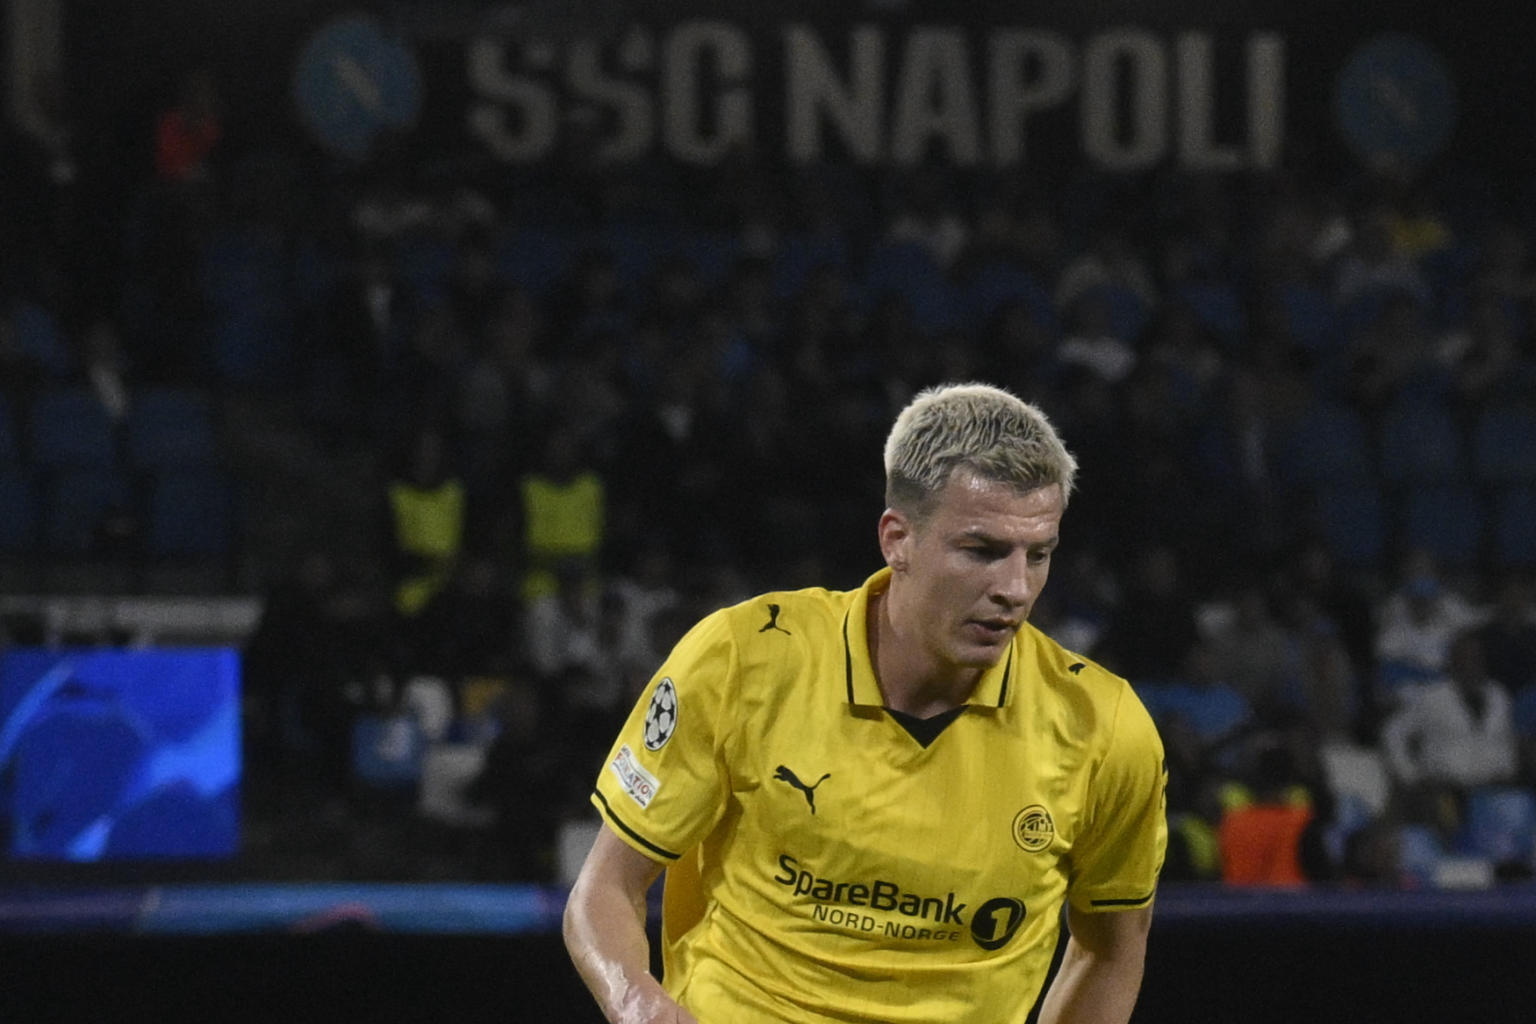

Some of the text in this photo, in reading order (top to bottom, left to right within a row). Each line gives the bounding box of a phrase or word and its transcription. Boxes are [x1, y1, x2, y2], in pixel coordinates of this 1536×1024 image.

[466, 17, 1290, 172] SSC NAPOLI
[774, 853, 968, 926] SpareBank
[812, 904, 961, 941] NORD-NORGE
